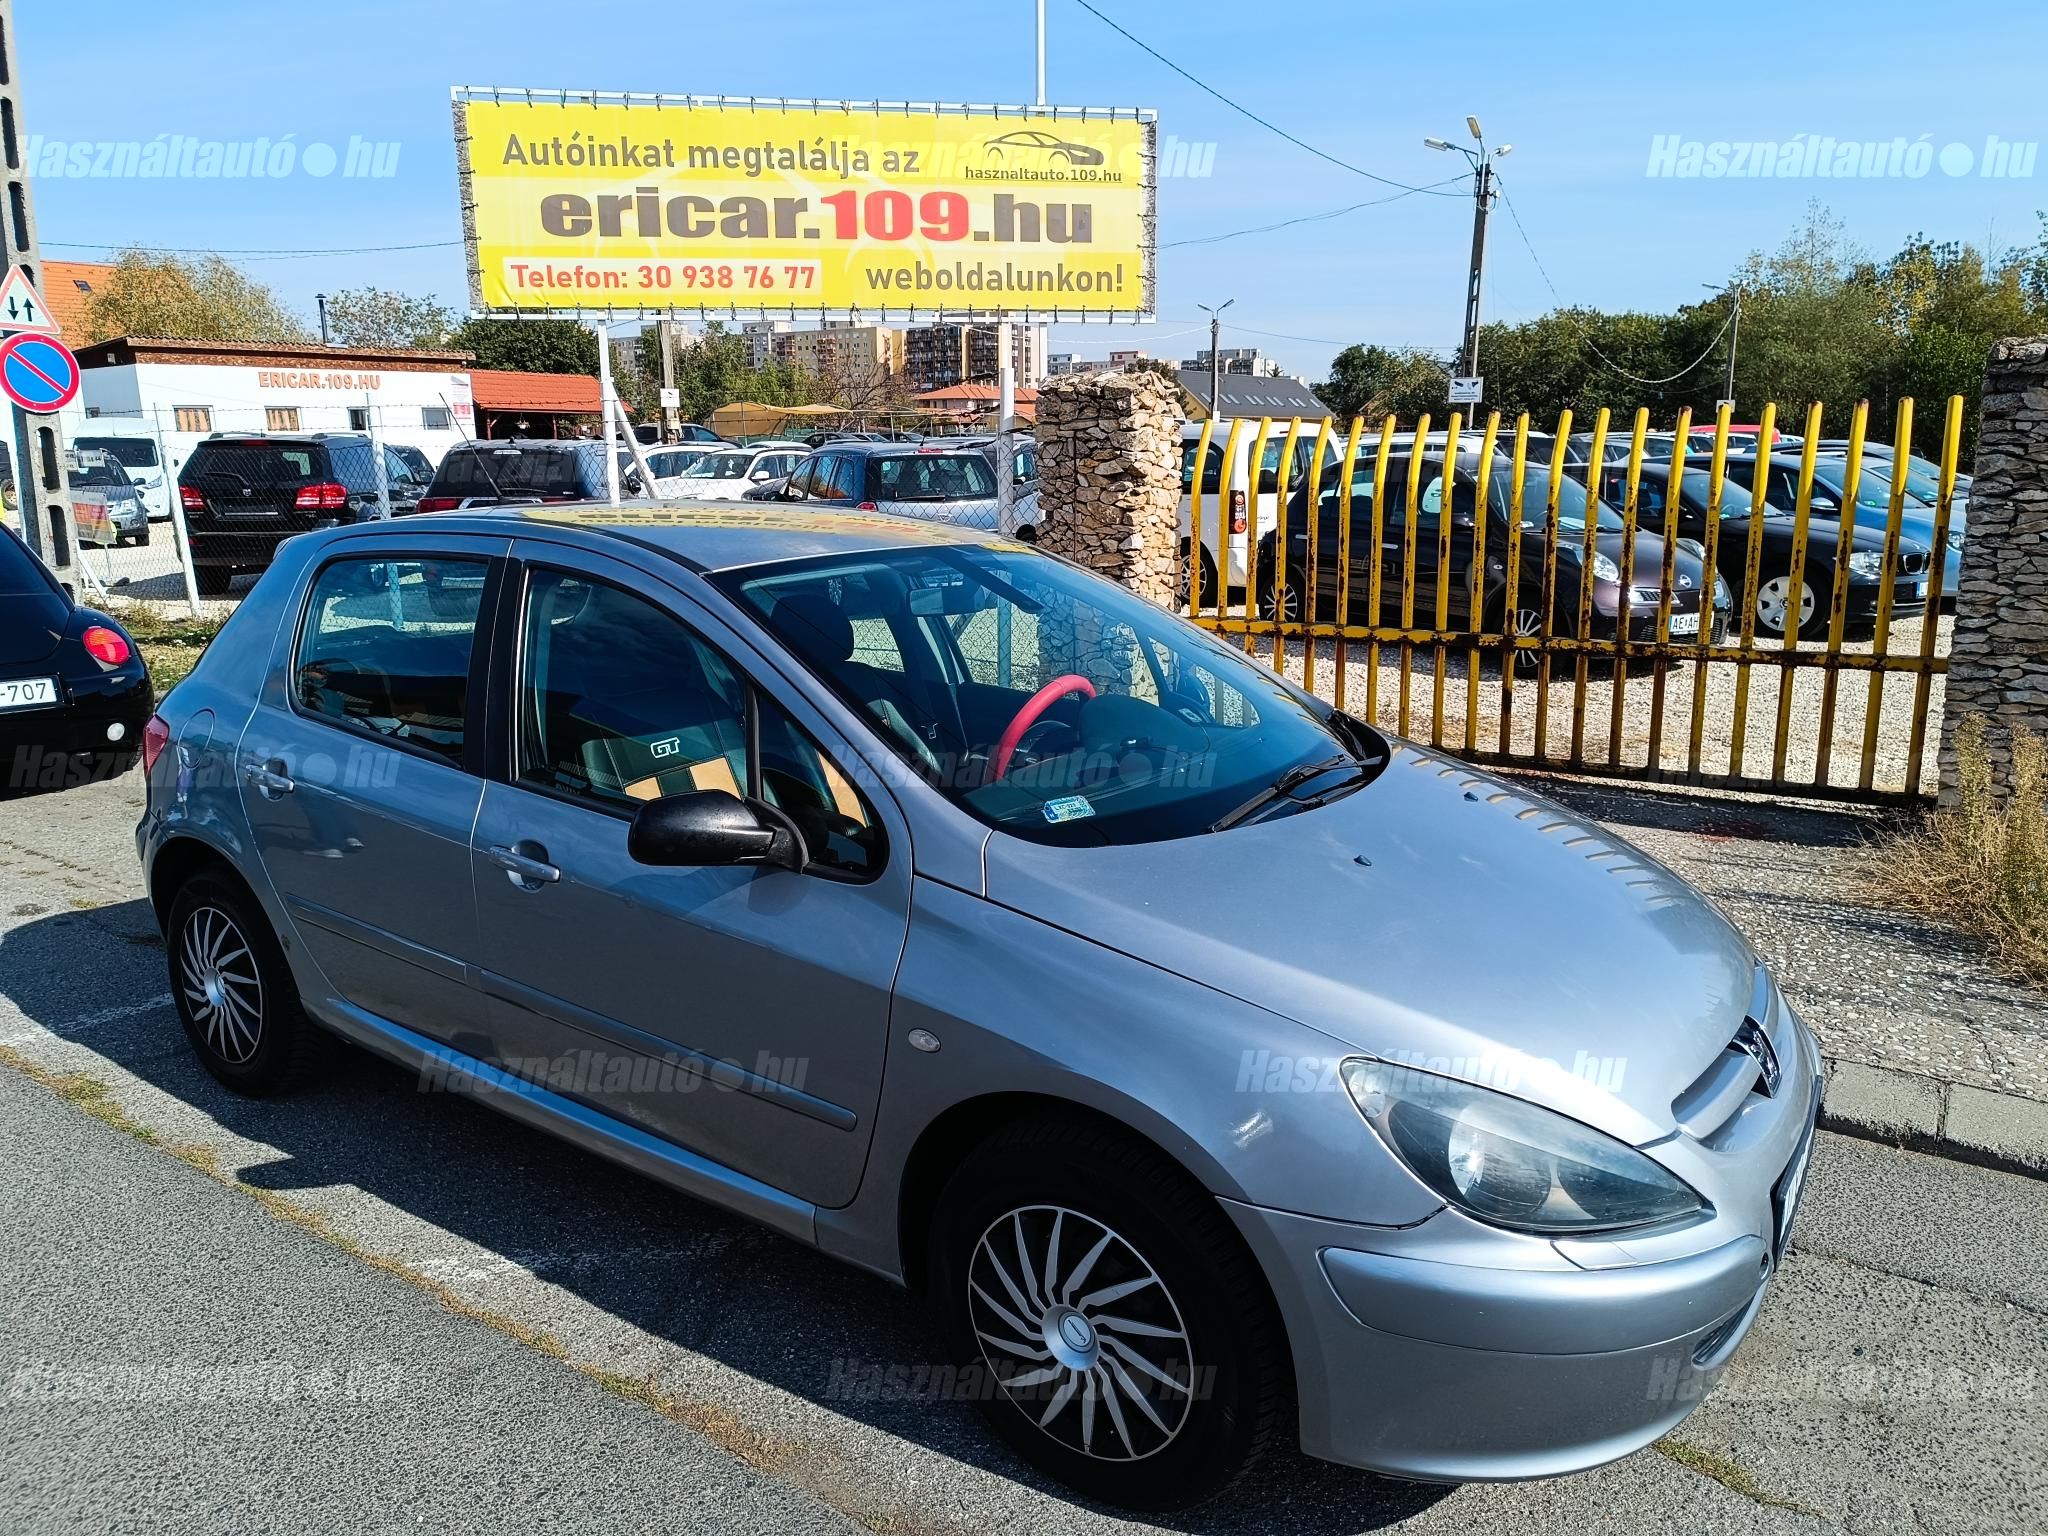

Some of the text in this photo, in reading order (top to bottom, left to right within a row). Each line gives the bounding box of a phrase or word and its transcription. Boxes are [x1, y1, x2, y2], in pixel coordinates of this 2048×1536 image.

[502, 131, 920, 179] Autóinkat megtalálja az
[965, 167, 1122, 182] hasznaltauto.109.hu
[540, 187, 1093, 243] ericar.109.hu
[511, 264, 815, 289] Telefon: 30 938 76 77
[866, 261, 1123, 292] weboldalunkon!
[258, 372, 380, 390] ERICAR.109.HU
[650, 737, 680, 758] GT
